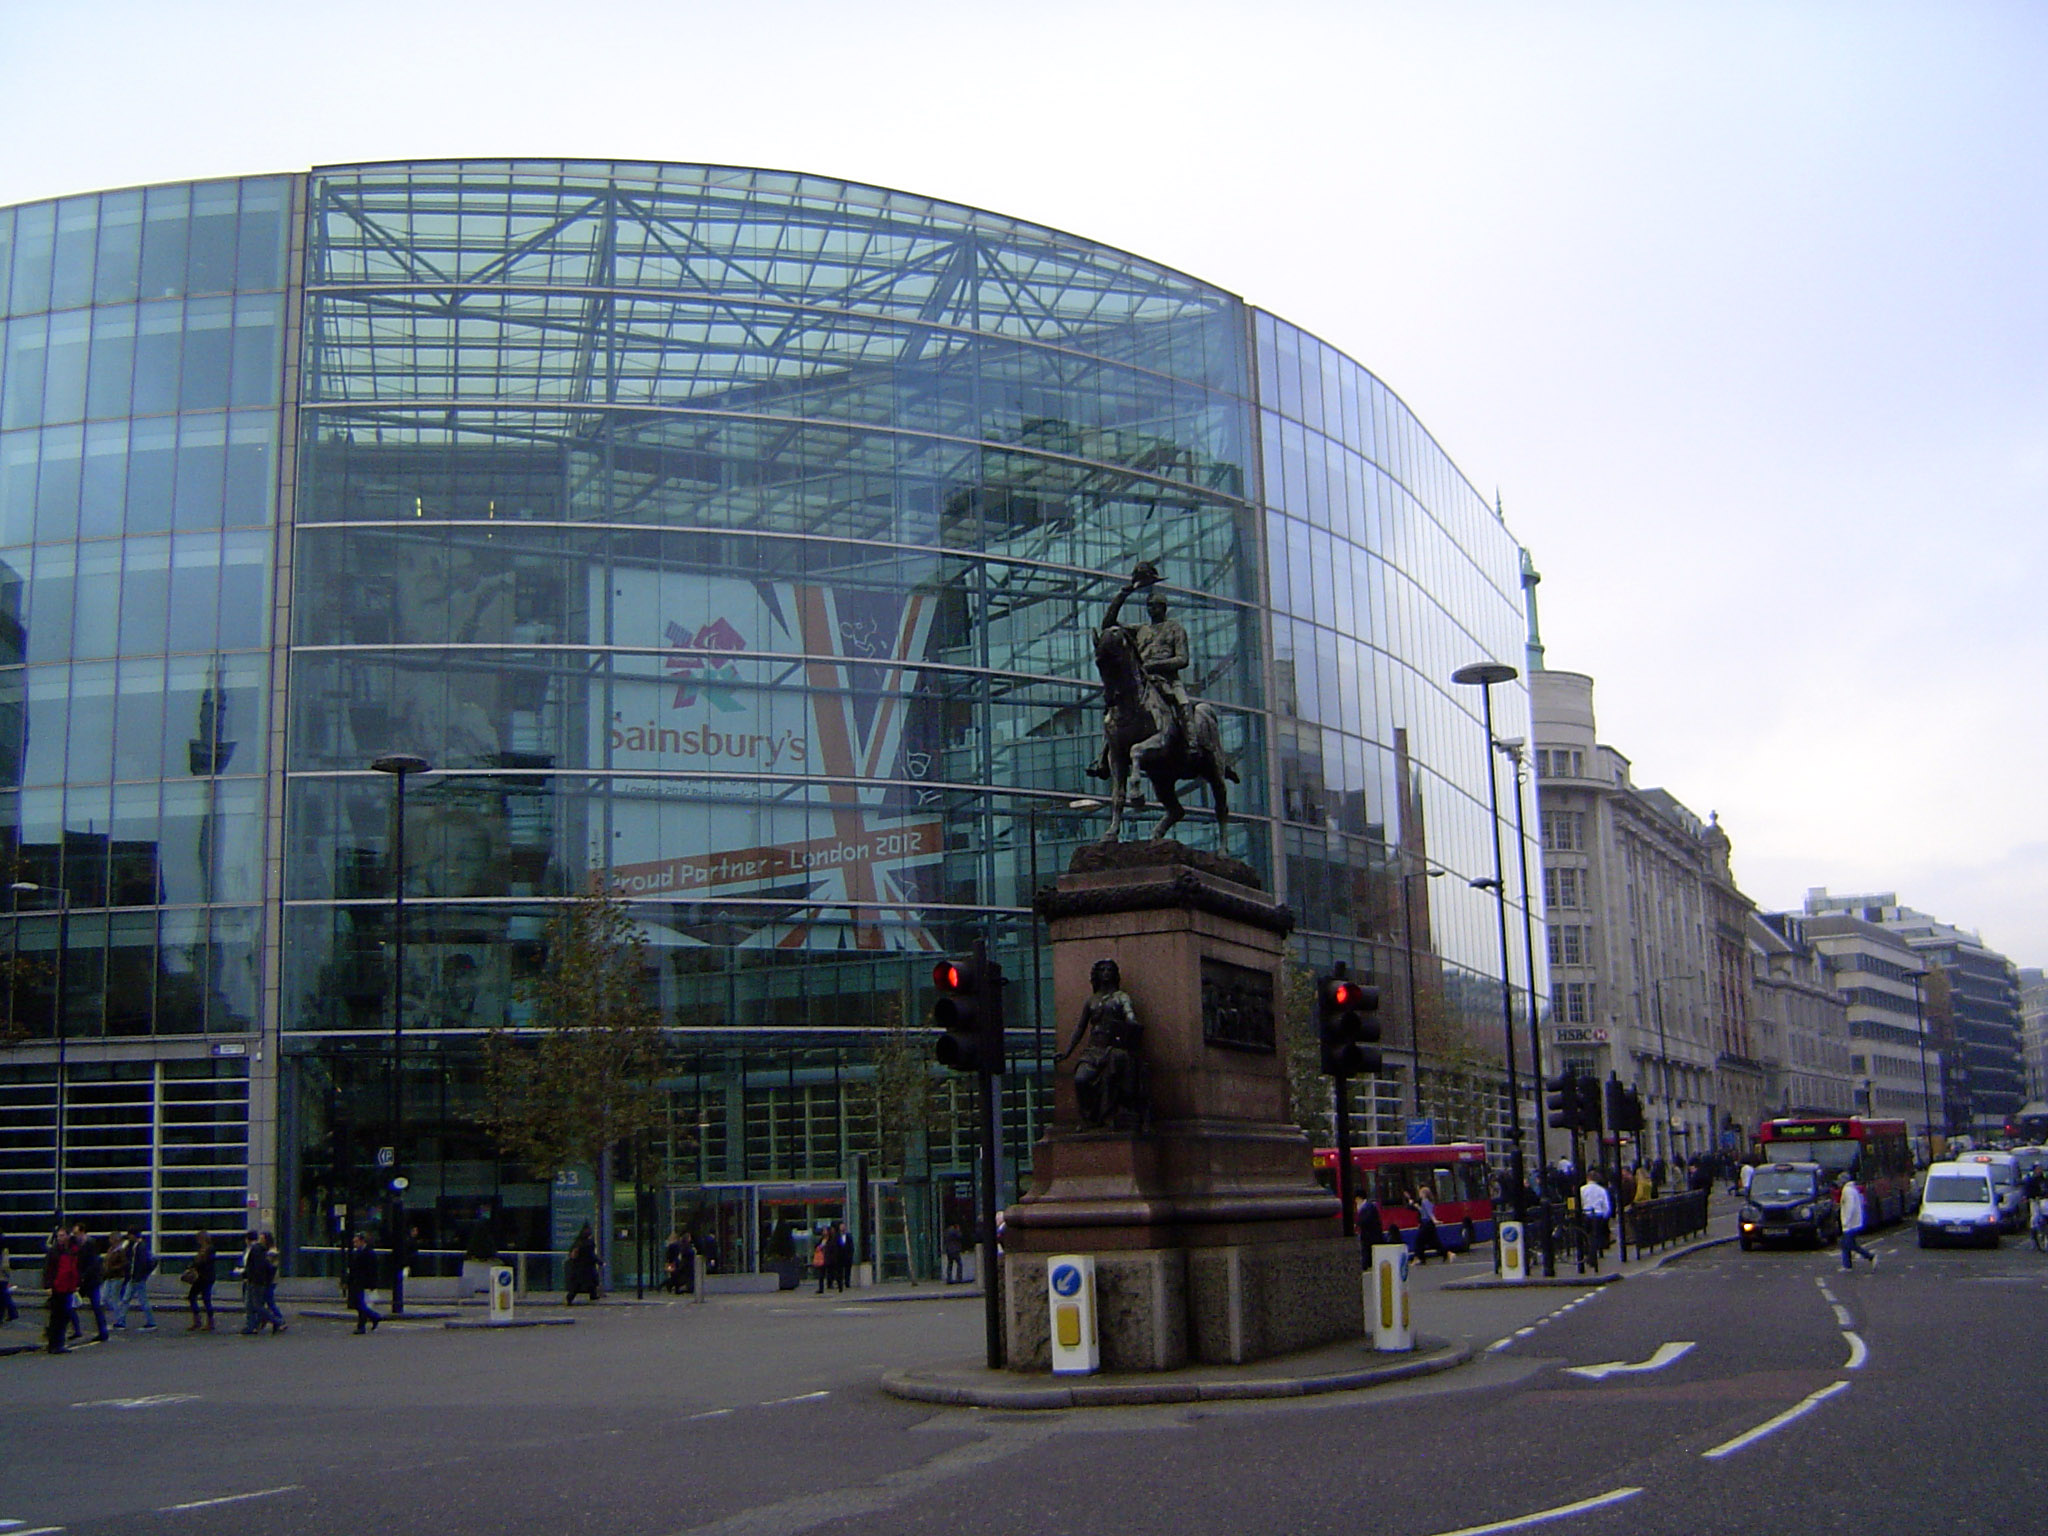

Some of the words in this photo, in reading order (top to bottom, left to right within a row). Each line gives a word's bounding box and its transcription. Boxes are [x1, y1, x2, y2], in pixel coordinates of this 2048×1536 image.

[610, 717, 806, 767] Sainsbury's
[681, 857, 768, 886] Partner
[790, 841, 870, 870] London
[875, 832, 923, 855] 2012
[1556, 1028, 1593, 1041] HSBC
[1828, 1123, 1842, 1135] 46
[556, 1170, 578, 1185] 33
